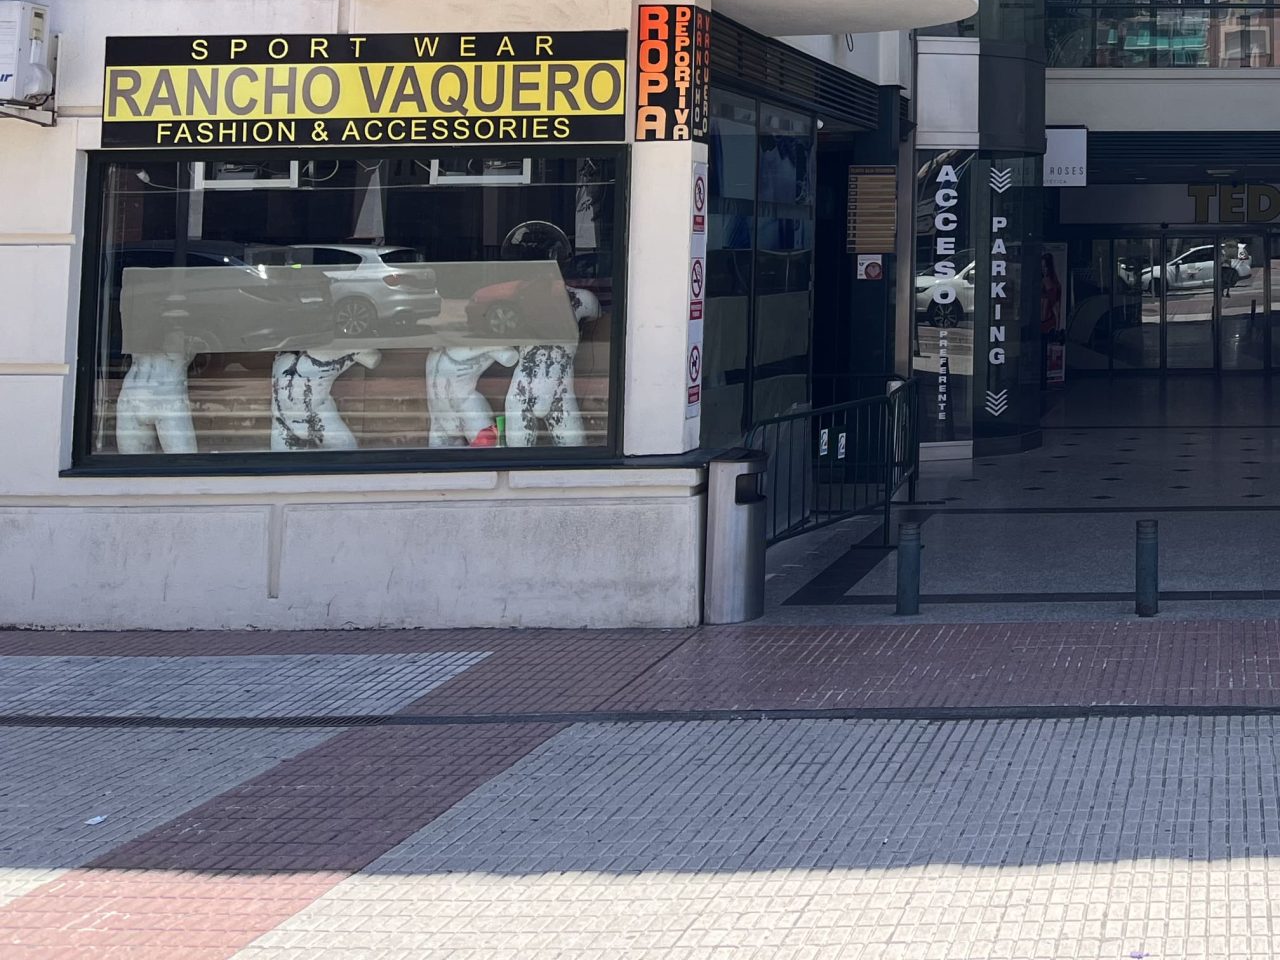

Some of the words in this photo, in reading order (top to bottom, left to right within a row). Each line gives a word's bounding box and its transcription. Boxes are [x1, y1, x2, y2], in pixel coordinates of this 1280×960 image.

[107, 64, 341, 117] RANCHO
[364, 61, 622, 117] VAQUERO
[191, 37, 366, 60] SPORT
[414, 35, 555, 58] WEAR
[636, 5, 669, 140] ROPA
[672, 6, 691, 140] DEPORTIVA
[693, 13, 704, 123] RANCHO
[702, 15, 711, 133] VAQUERO
[156, 121, 296, 144] FASHION
[311, 121, 329, 142] &
[341, 117, 571, 142] ACCESSORIES
[1049, 166, 1084, 176] ROSES
[933, 164, 959, 304] ACCESO
[989, 216, 1008, 365] PARKING
